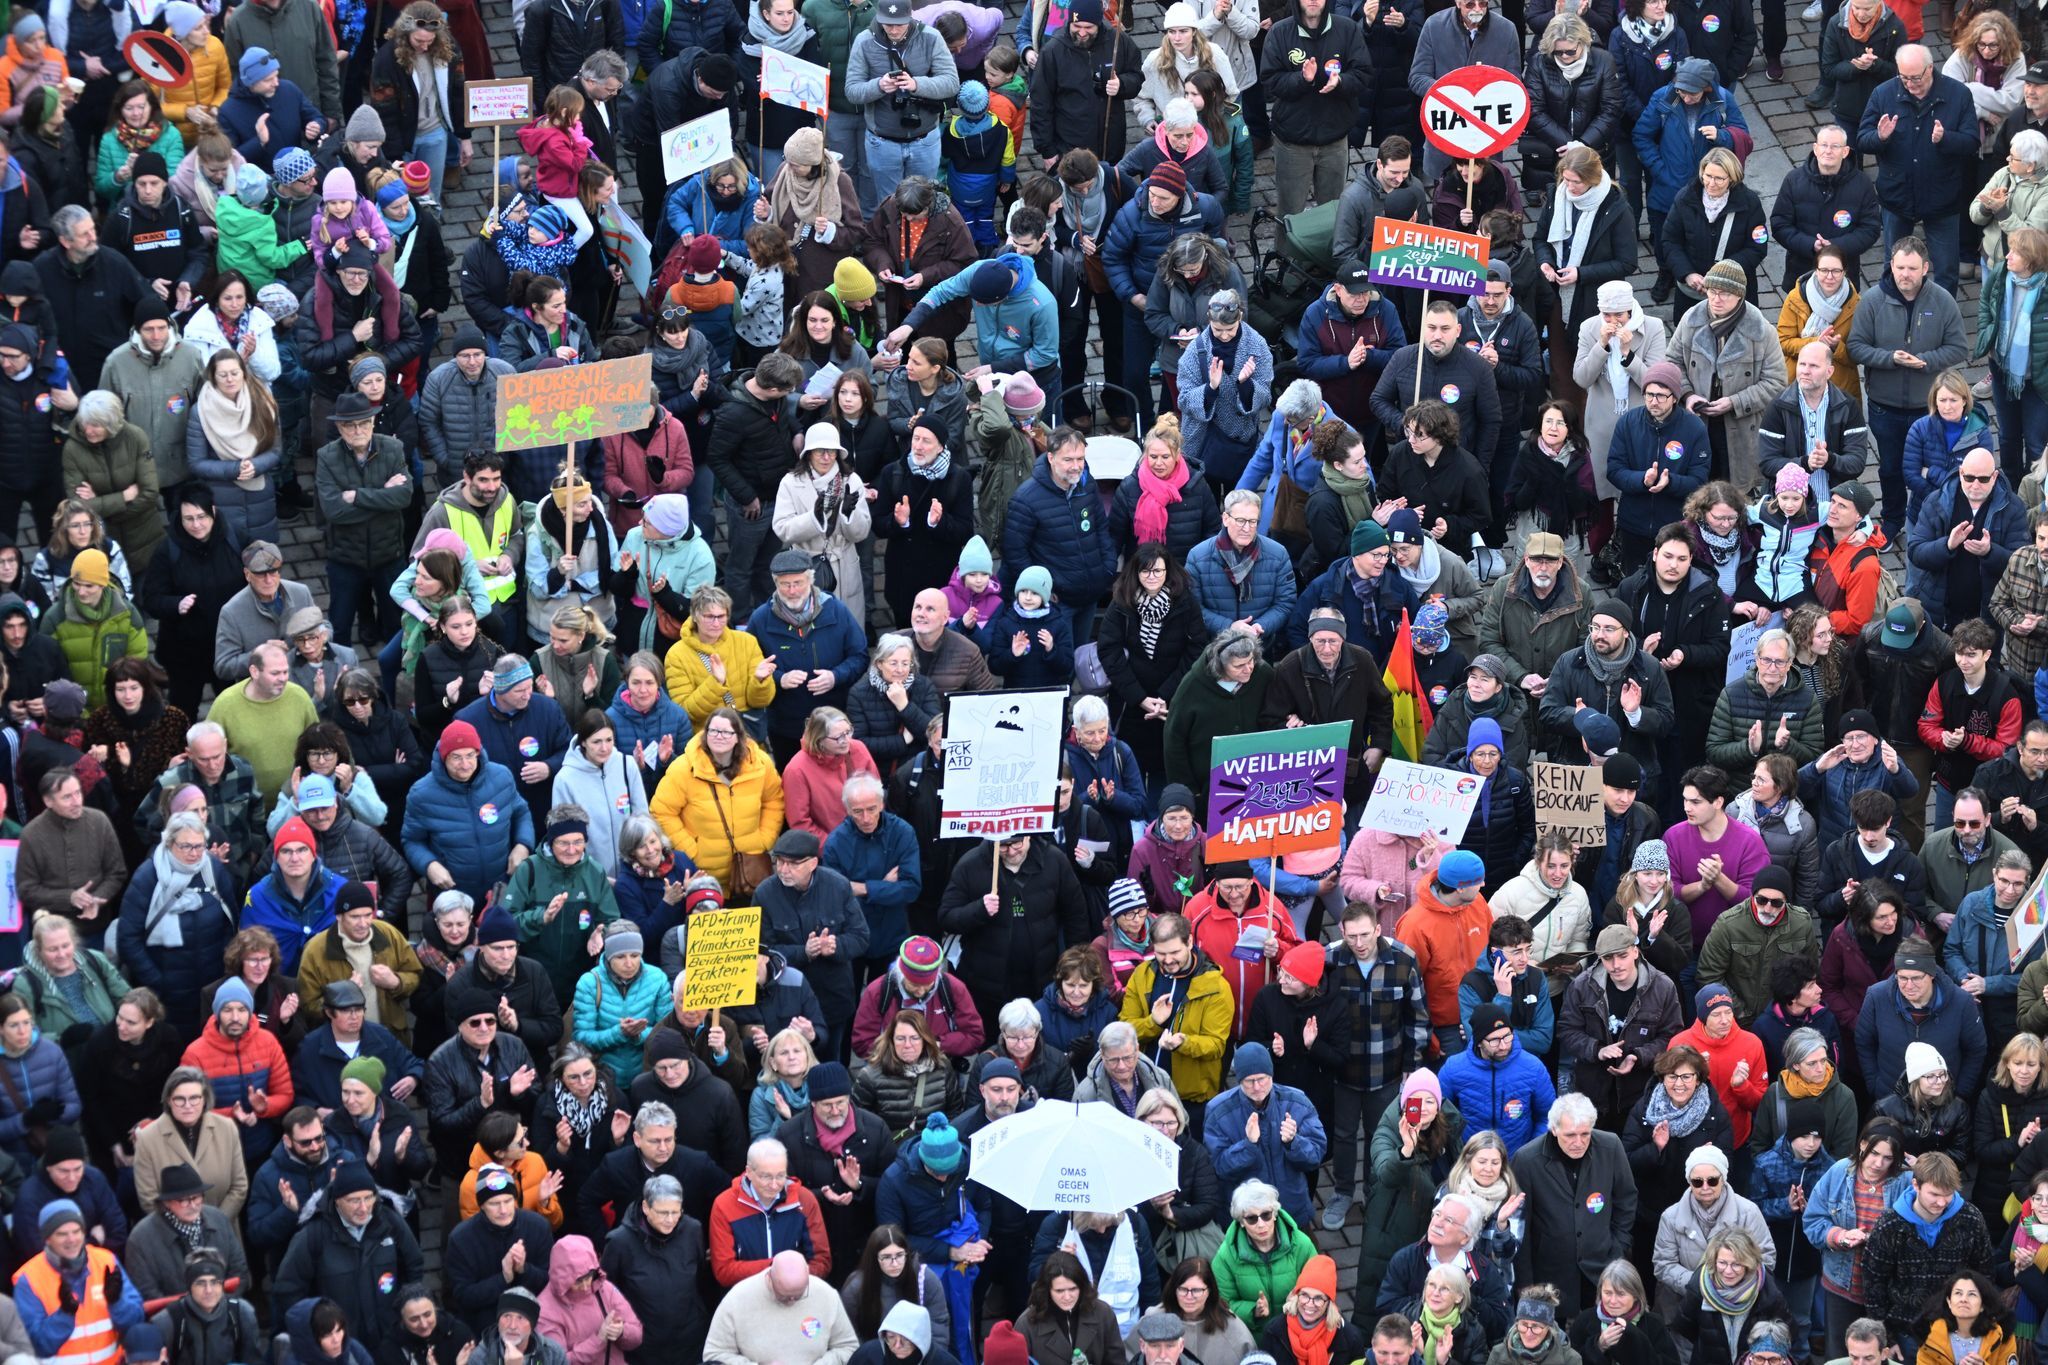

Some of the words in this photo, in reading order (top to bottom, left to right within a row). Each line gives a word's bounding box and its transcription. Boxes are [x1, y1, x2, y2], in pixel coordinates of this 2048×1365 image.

[1430, 102, 1513, 131] HATE
[1383, 225, 1480, 260] WEILHEIM
[1377, 254, 1478, 288] HALTUNG
[504, 362, 615, 401] DEMOKRATIE
[979, 760, 1036, 785] HUY
[1223, 745, 1337, 776] WEILHEIM
[1537, 764, 1585, 792] KEIN
[977, 781, 1040, 807] BUH!
[1373, 777, 1476, 813] DEMOKRATIE
[1222, 809, 1332, 846] HALTUNG
[688, 937, 756, 955] Klimakrise
[1057, 1180, 1090, 1190] GEGEN
[1060, 1167, 1087, 1178] OMAS
[1054, 1193, 1091, 1204] RECHTS
